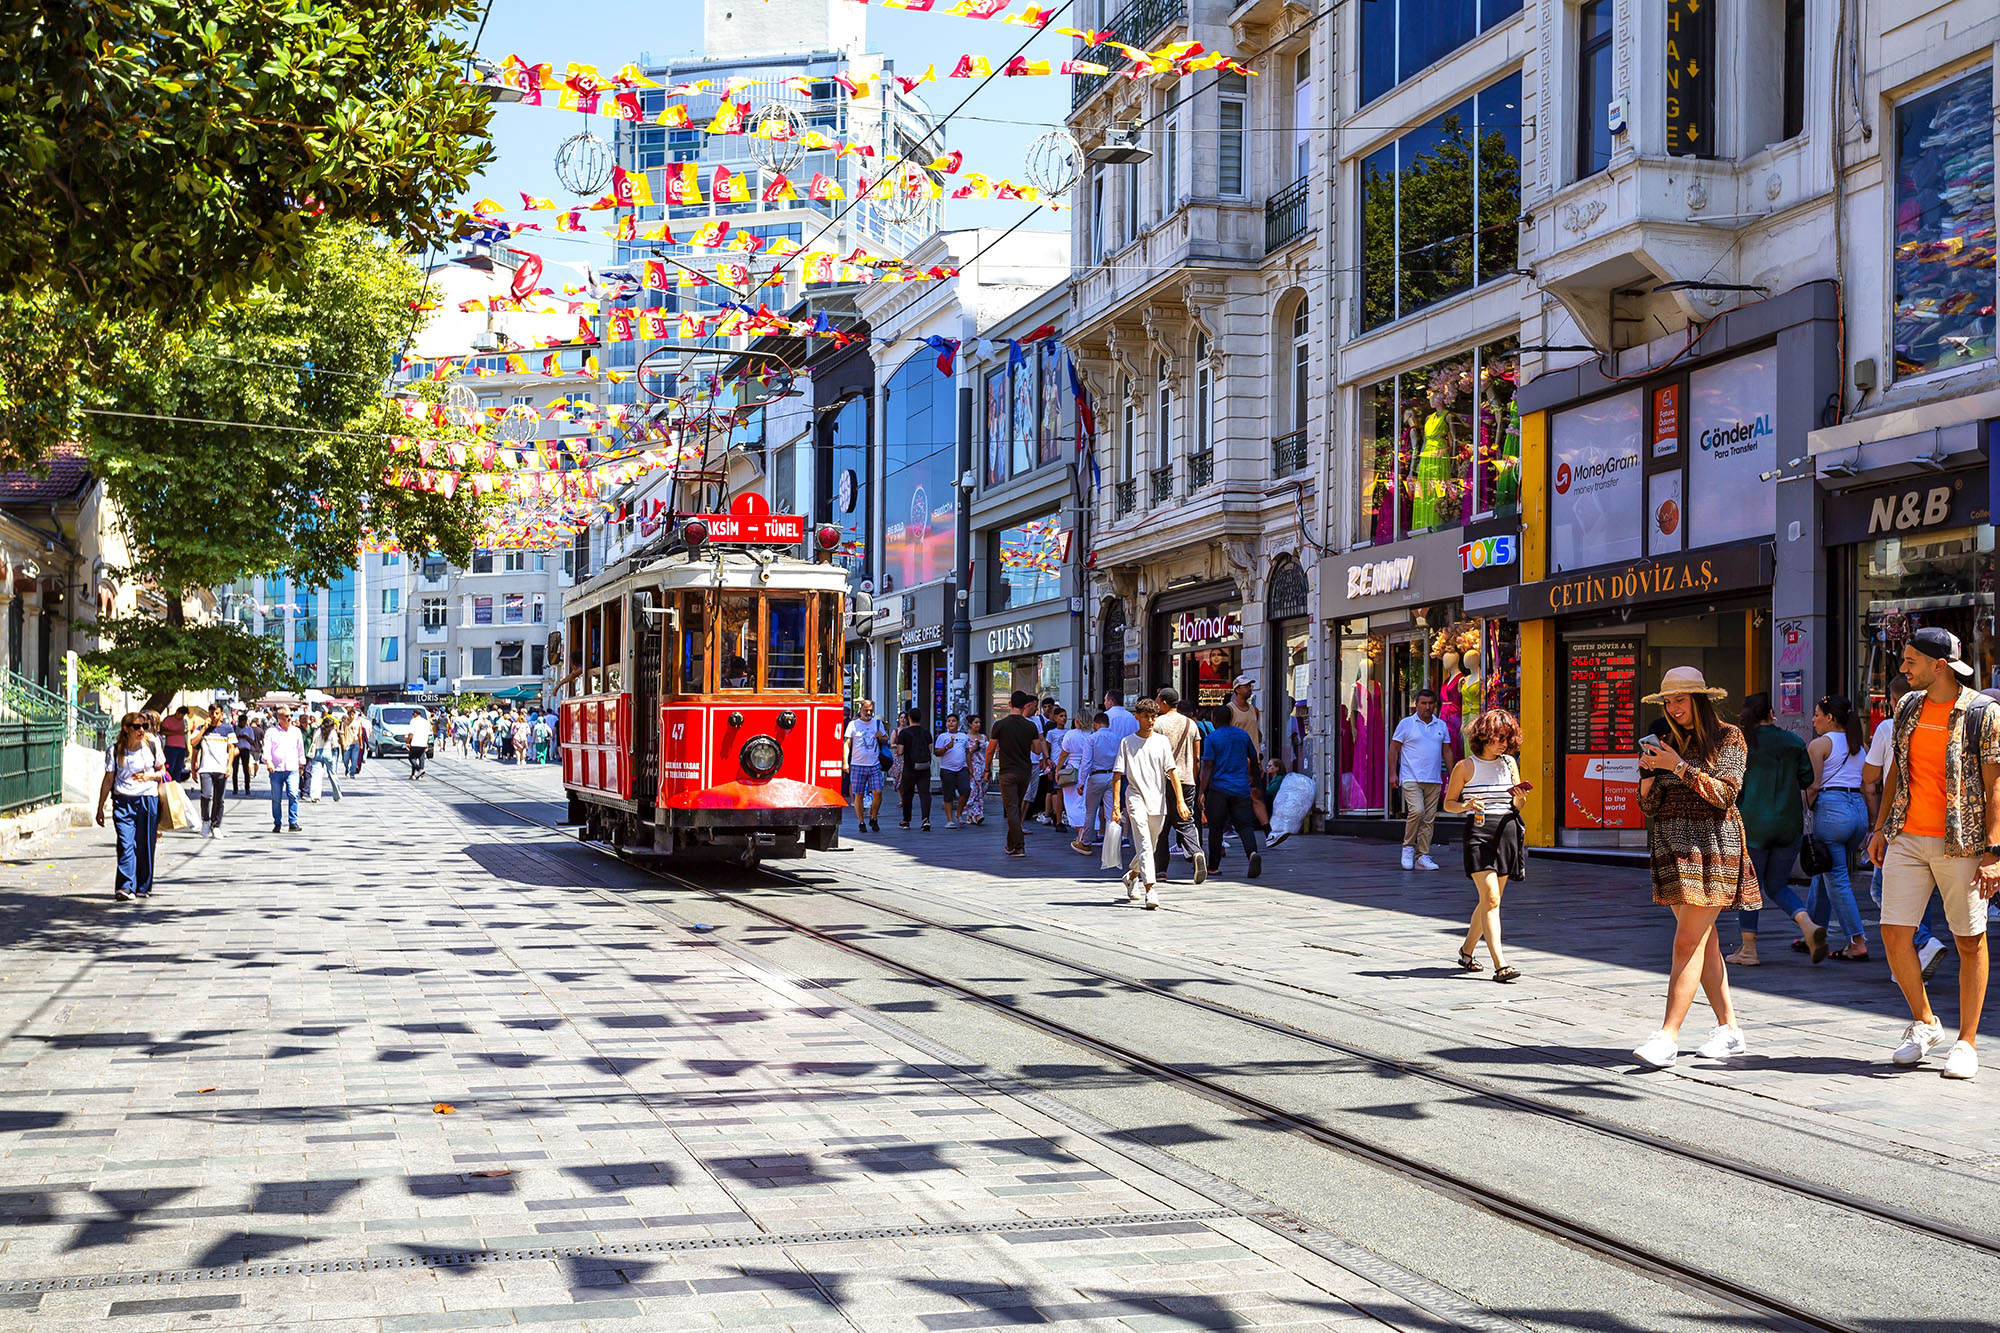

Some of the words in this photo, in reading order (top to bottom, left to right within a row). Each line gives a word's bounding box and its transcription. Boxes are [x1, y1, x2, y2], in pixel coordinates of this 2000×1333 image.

[1667, 0, 1679, 147] HANGE
[1660, 409, 1675, 419] Fatura
[1701, 414, 1773, 451] GönderAL
[1715, 449, 1729, 460] Para
[1730, 441, 1758, 457] Transferi
[1574, 483, 1594, 495] money
[1594, 478, 1619, 491] transfer
[747, 496, 753, 514] 1
[1868, 487, 1950, 533] N&B
[708, 517, 739, 536] AKSİM
[764, 519, 799, 537] TÜNEL
[1458, 536, 1515, 573] TOYS
[1347, 555, 1414, 600] BENNY
[1550, 575, 1605, 613] ÇETİN
[1611, 563, 1674, 599] DÖVİZ
[1680, 560, 1718, 592] A.Ş.
[901, 628, 921, 646] CHANGE
[922, 624, 940, 641] OFFICE
[988, 623, 1032, 654] GUESS
[1178, 613, 1227, 642] flormar
[418, 694, 438, 702] LORIS
[672, 723, 684, 740] 47
